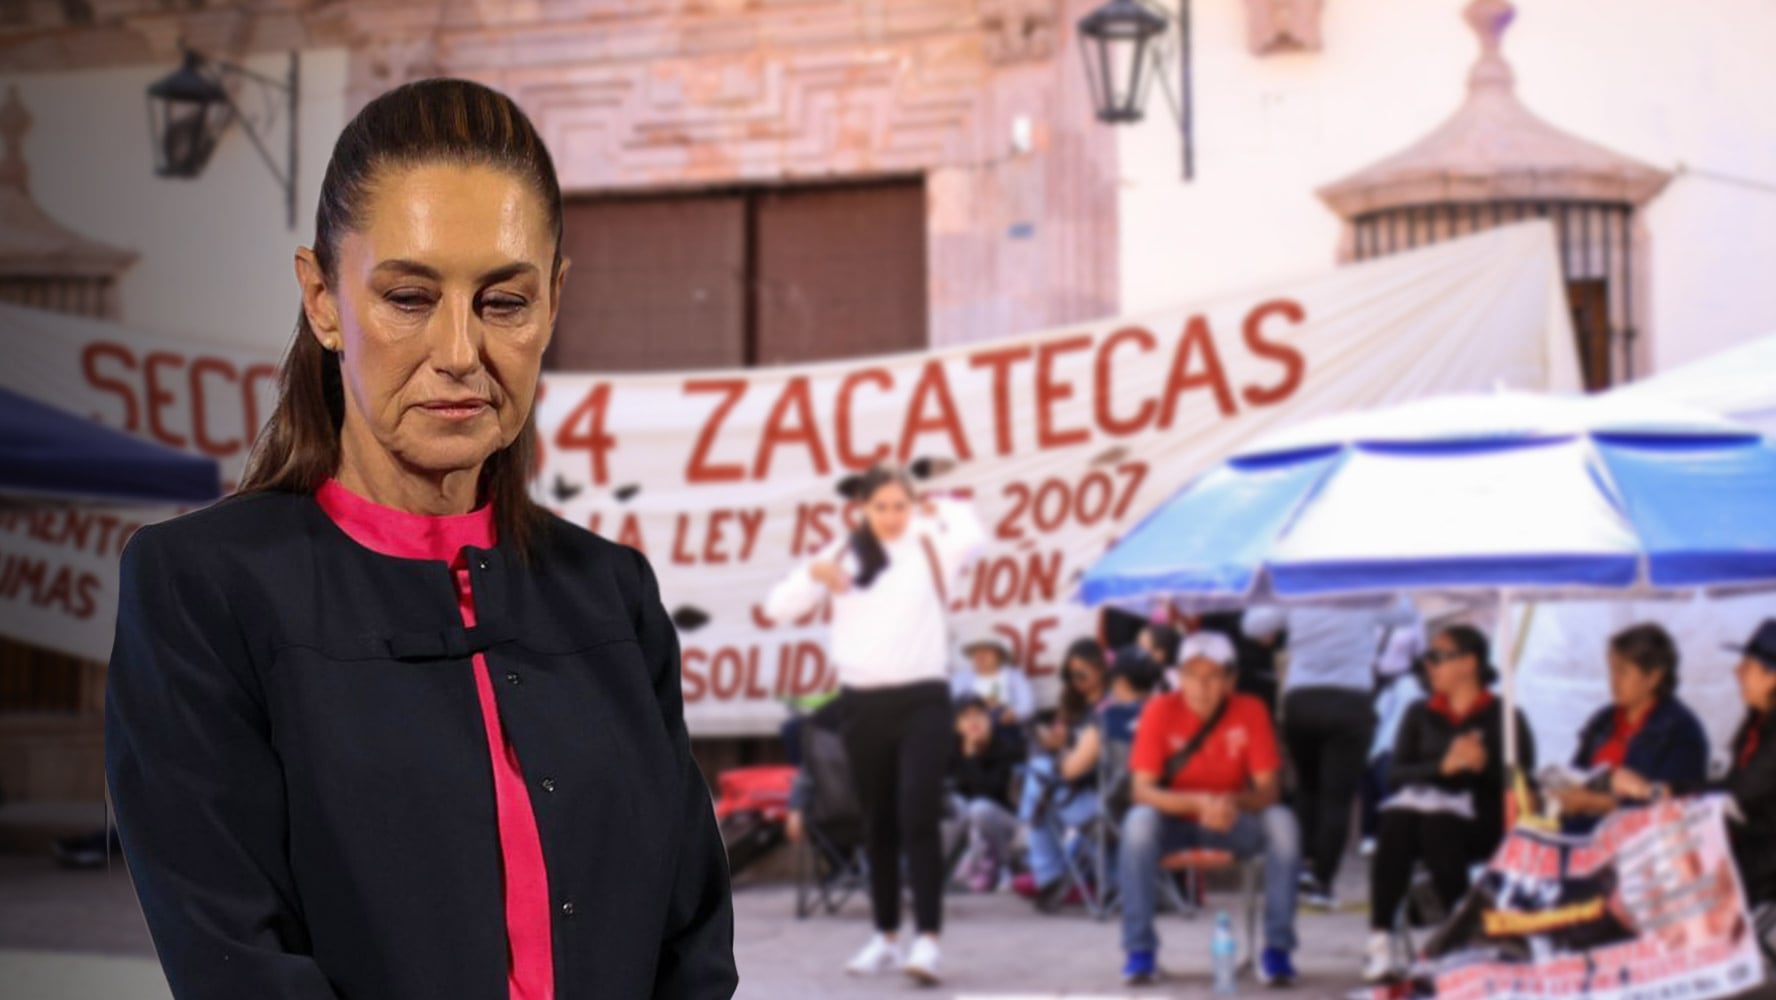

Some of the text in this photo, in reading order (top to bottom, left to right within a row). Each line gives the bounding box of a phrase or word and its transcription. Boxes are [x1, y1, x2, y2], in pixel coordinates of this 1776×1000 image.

[534, 380, 617, 486] 4
[682, 299, 1306, 485] ZACATECAS
[671, 508, 766, 565] LEY
[996, 462, 1149, 541] 2007
